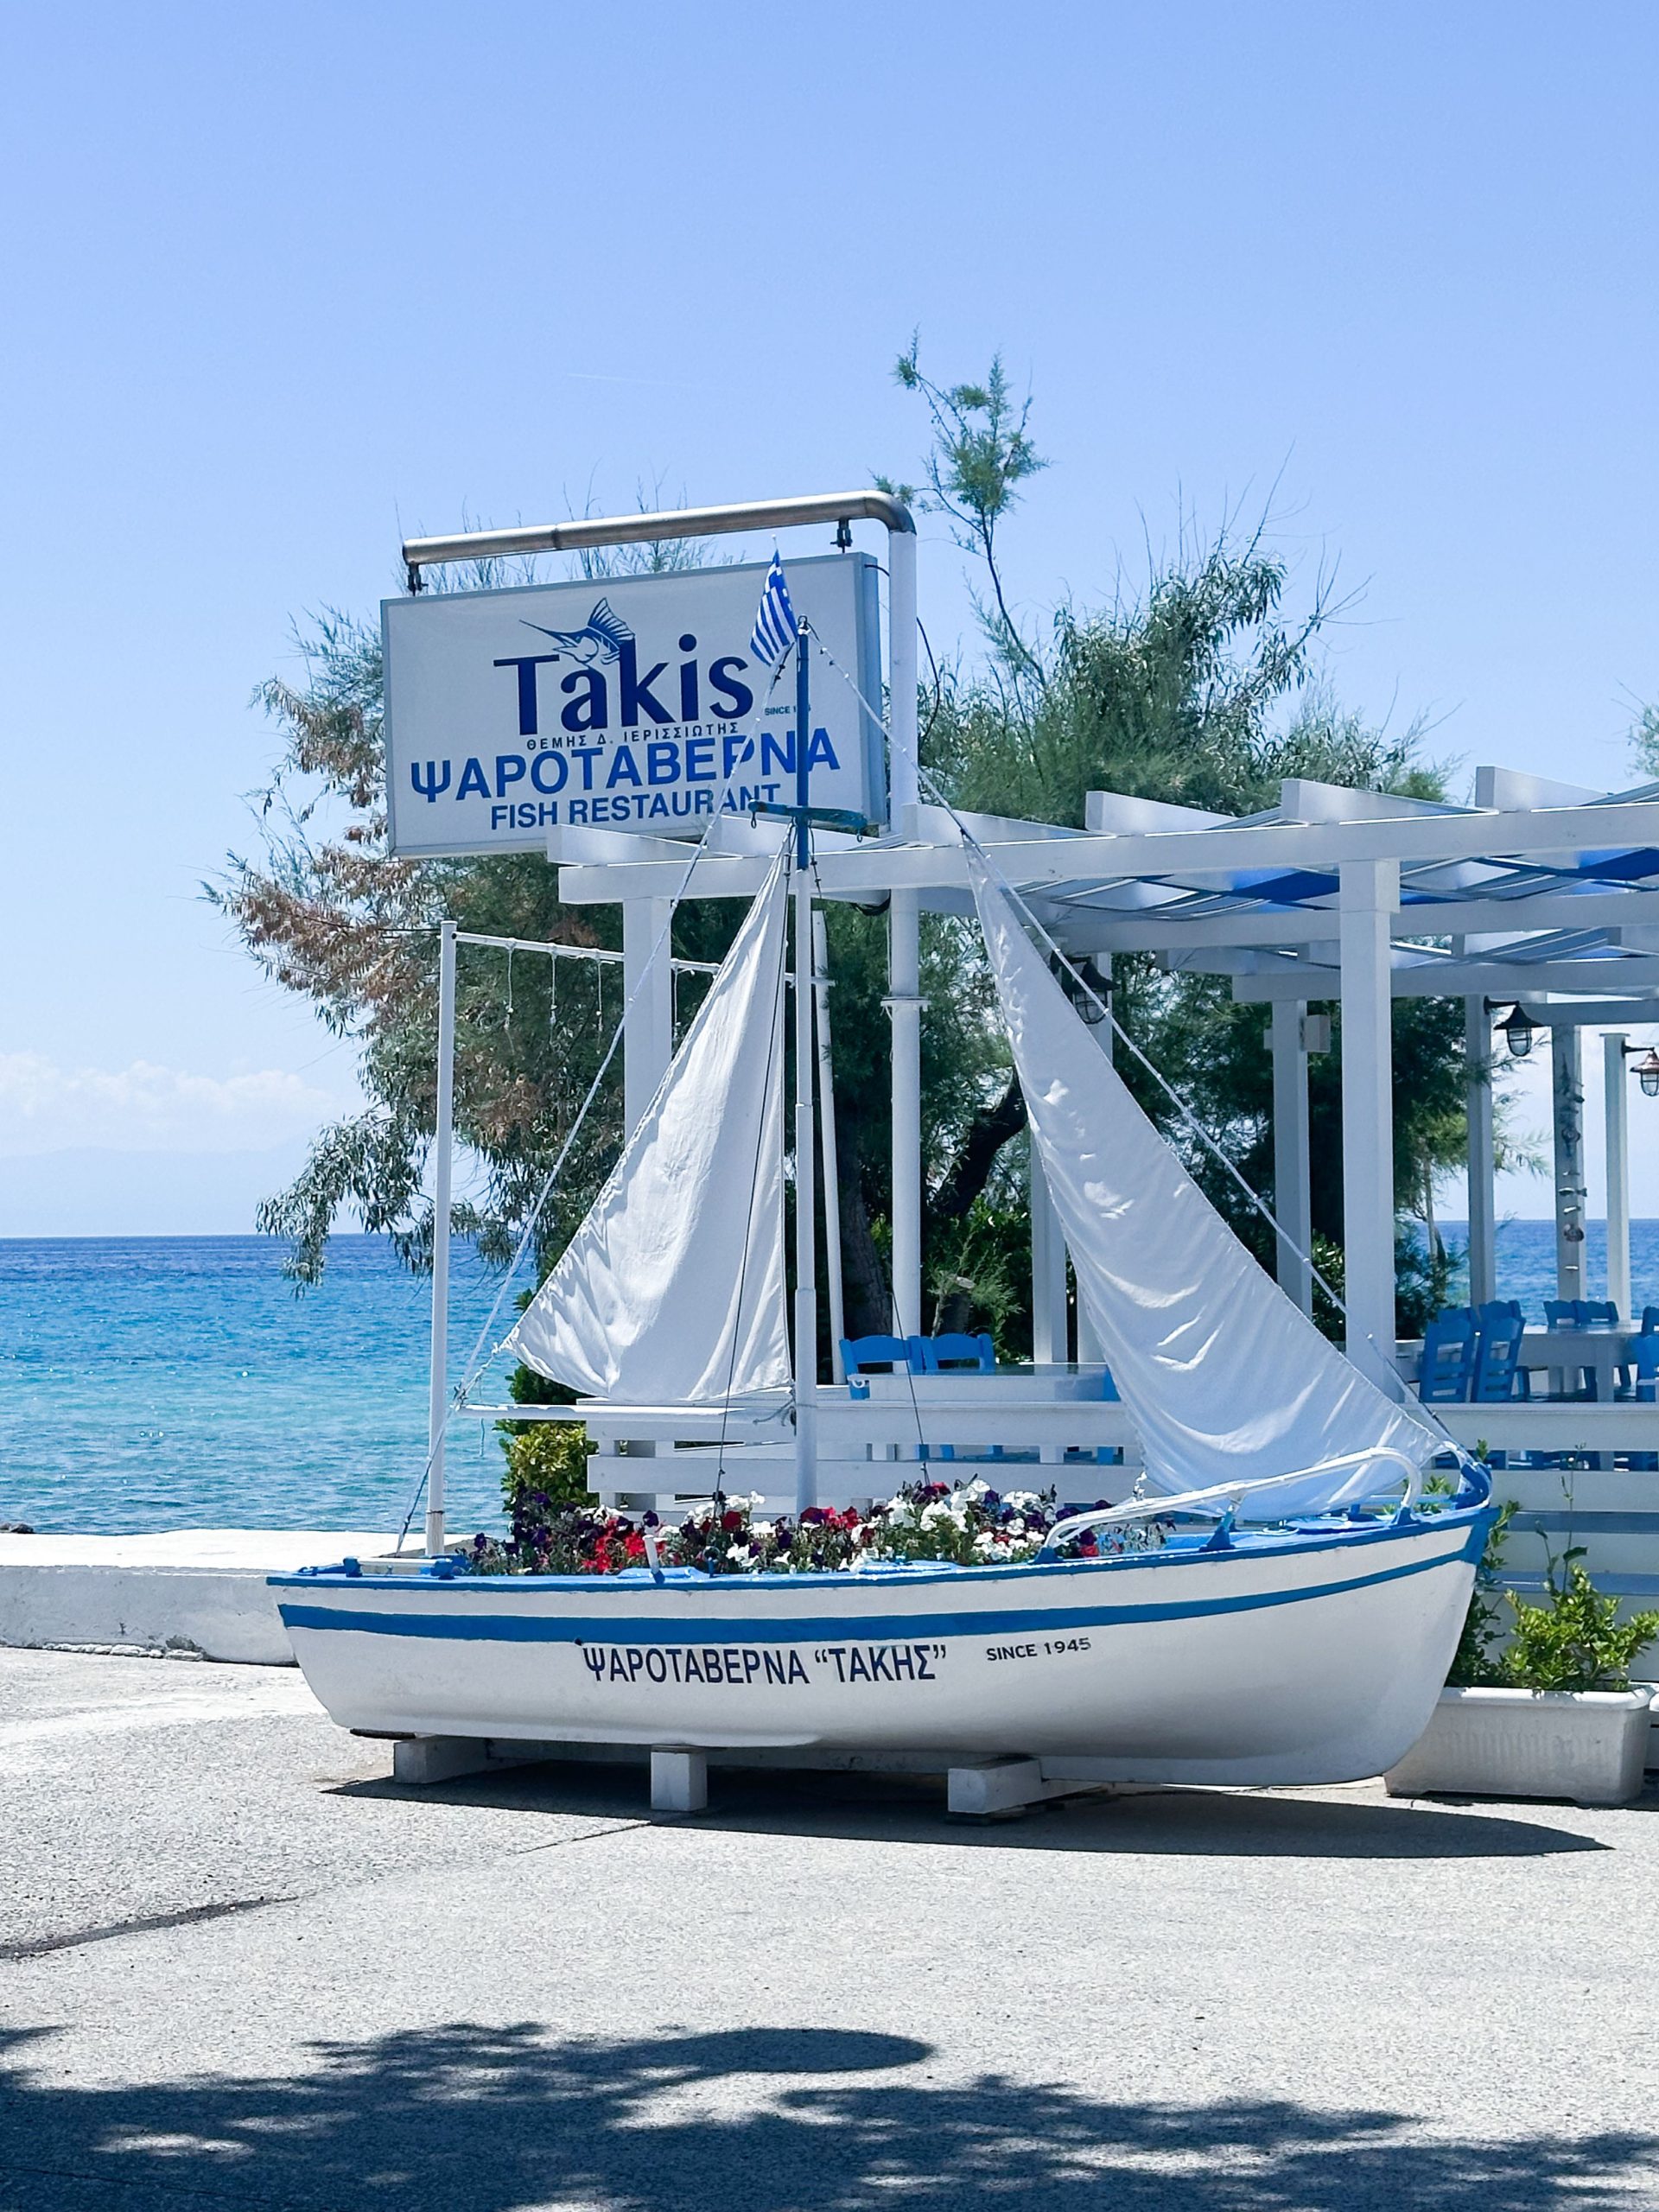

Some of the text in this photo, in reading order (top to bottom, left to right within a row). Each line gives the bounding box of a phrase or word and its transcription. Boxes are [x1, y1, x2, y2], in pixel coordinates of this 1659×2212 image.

[493, 633, 754, 735] Takis
[764, 705, 791, 716] SINCE
[526, 721, 740, 751] ΘΕΜΗΣ Δ. ΙΕΡΙΣΣΙΩΤΗΣ
[410, 728, 841, 804] ΨΑΡΟΤΑΒΕΡΝΑ
[490, 783, 781, 830] FISH RESTAURANT
[583, 1643, 947, 1685] ΨΑΡΟΤΑΒΕΡΝΑ “ΤΑΚΗΣ”
[986, 1637, 1092, 1661] SINCE 1945
